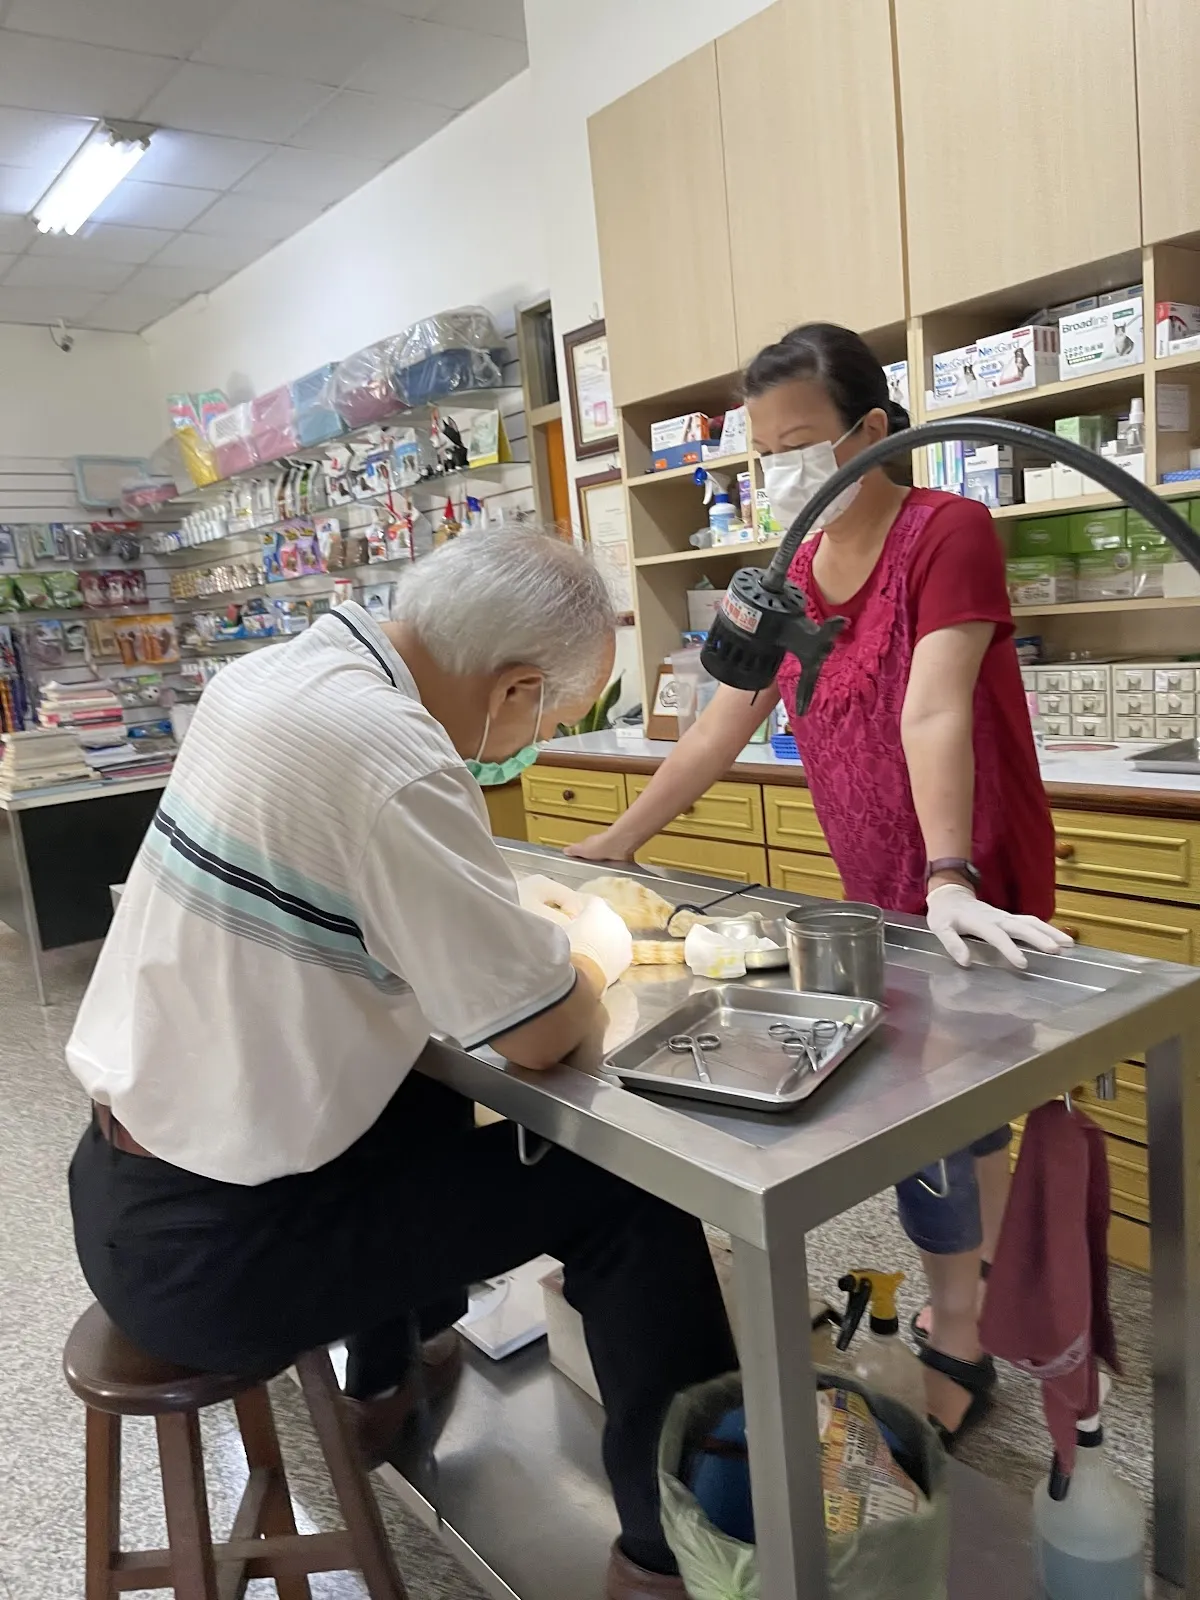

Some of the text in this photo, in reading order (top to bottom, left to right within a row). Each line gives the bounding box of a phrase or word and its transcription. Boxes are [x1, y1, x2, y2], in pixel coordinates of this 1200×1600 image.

[1062, 313, 1109, 334] Broadline
[979, 340, 1020, 358] NexGard
[934, 354, 973, 372] NexGard
